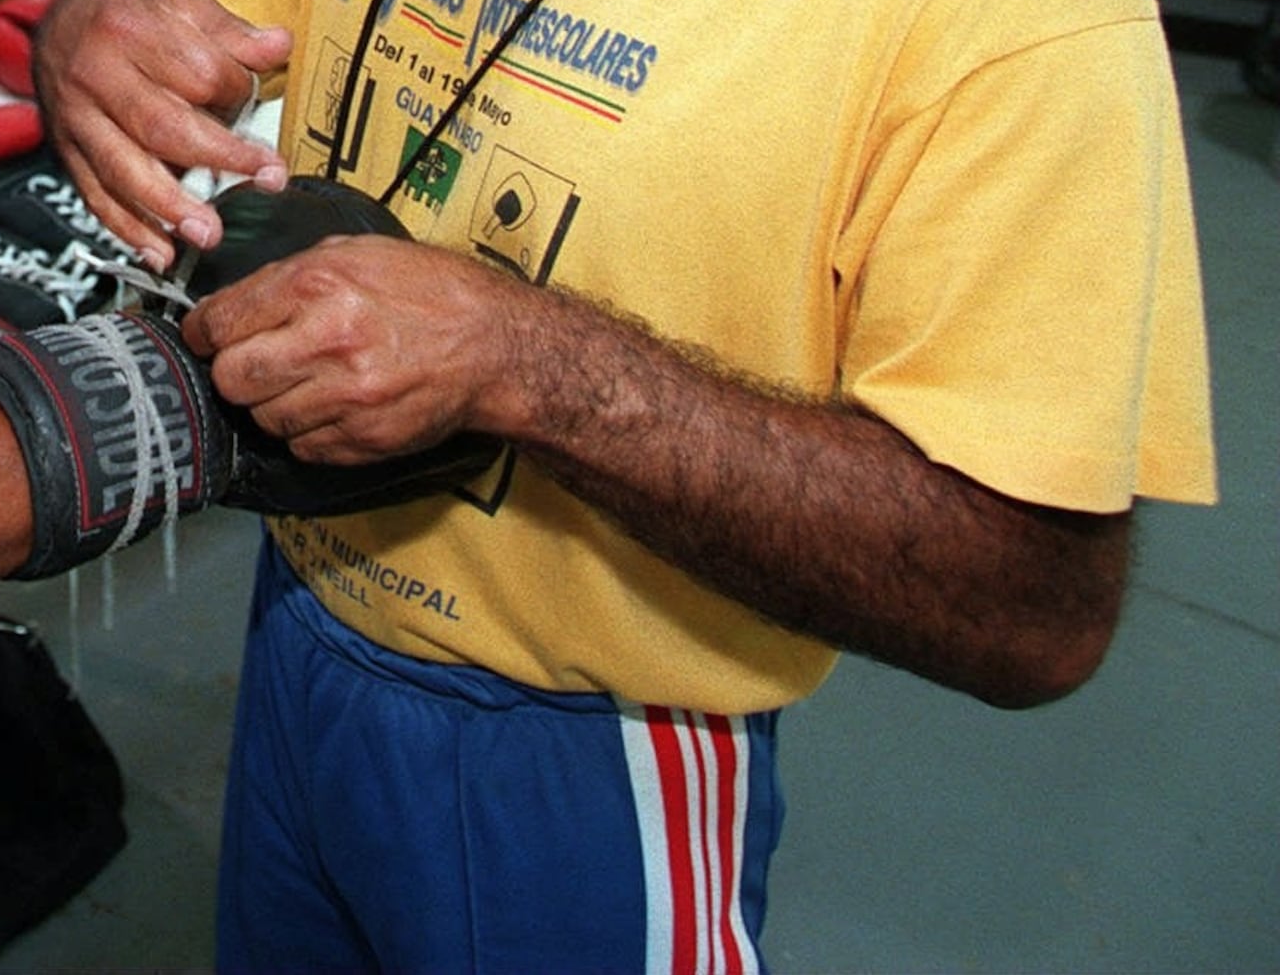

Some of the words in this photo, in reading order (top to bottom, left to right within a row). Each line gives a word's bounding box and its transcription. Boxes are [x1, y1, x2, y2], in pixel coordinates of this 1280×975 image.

[373, 34, 404, 63] Del
[409, 53, 419, 71] 1
[418, 65, 436, 84] al
[478, 93, 512, 126] Mayo
[395, 85, 484, 154] GUANBO
[331, 534, 461, 621] MUNICIPAL
